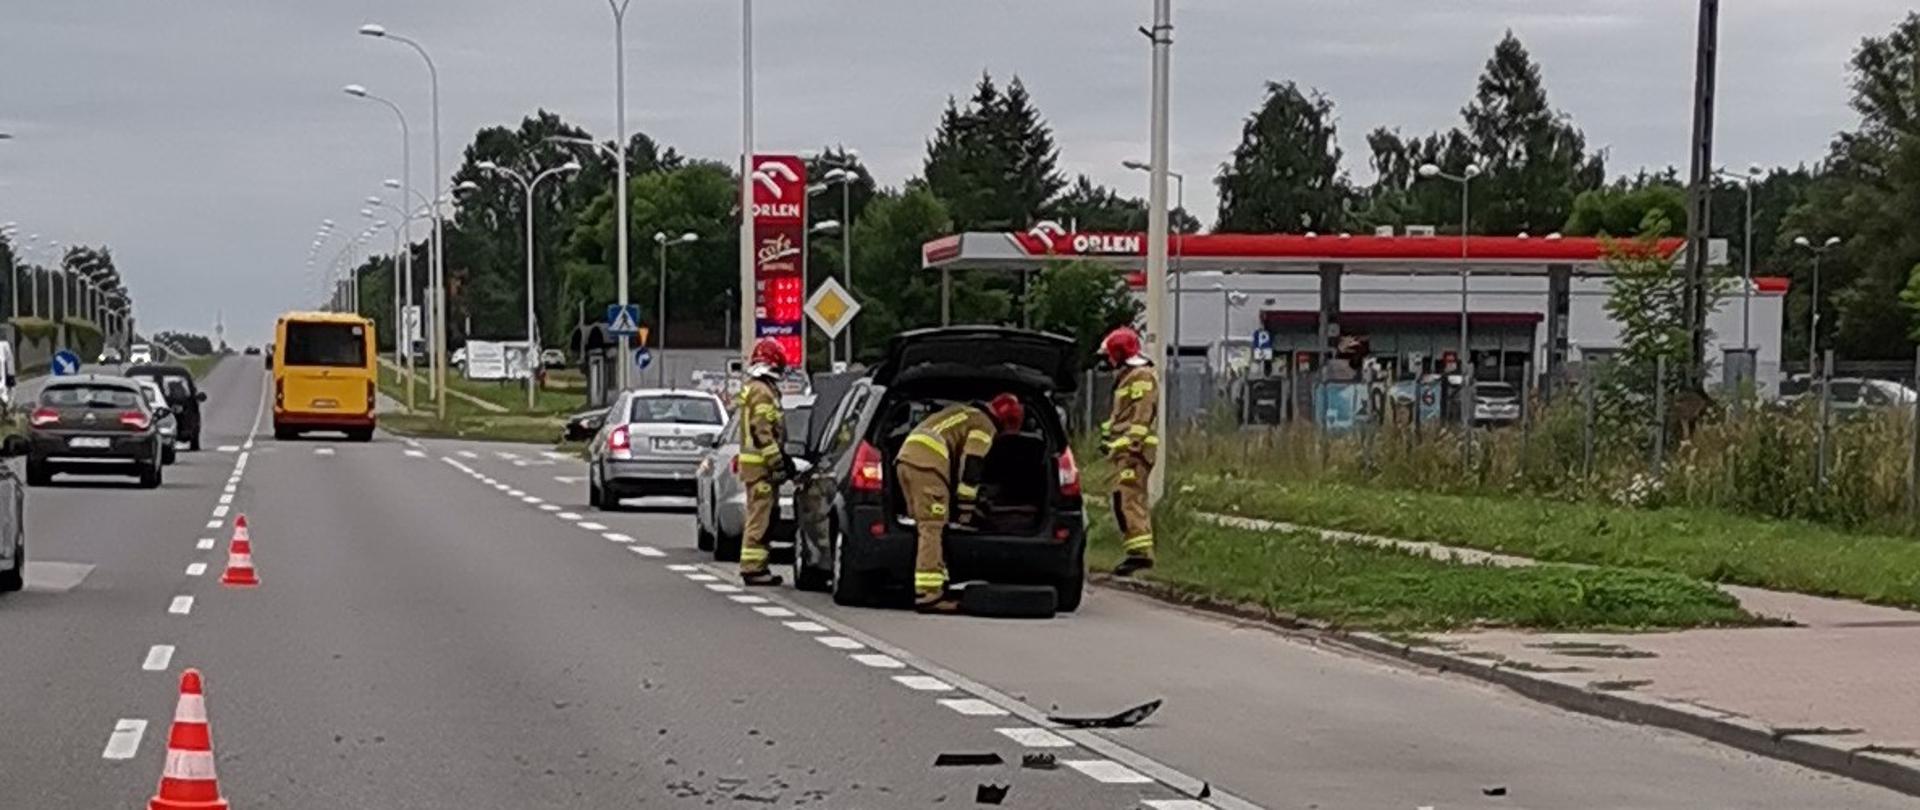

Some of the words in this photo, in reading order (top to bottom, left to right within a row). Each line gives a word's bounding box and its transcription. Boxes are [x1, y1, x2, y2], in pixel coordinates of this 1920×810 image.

[752, 203, 800, 217] ORLEN
[1073, 235, 1140, 253] ORLEN
[1258, 331, 1269, 346] P
